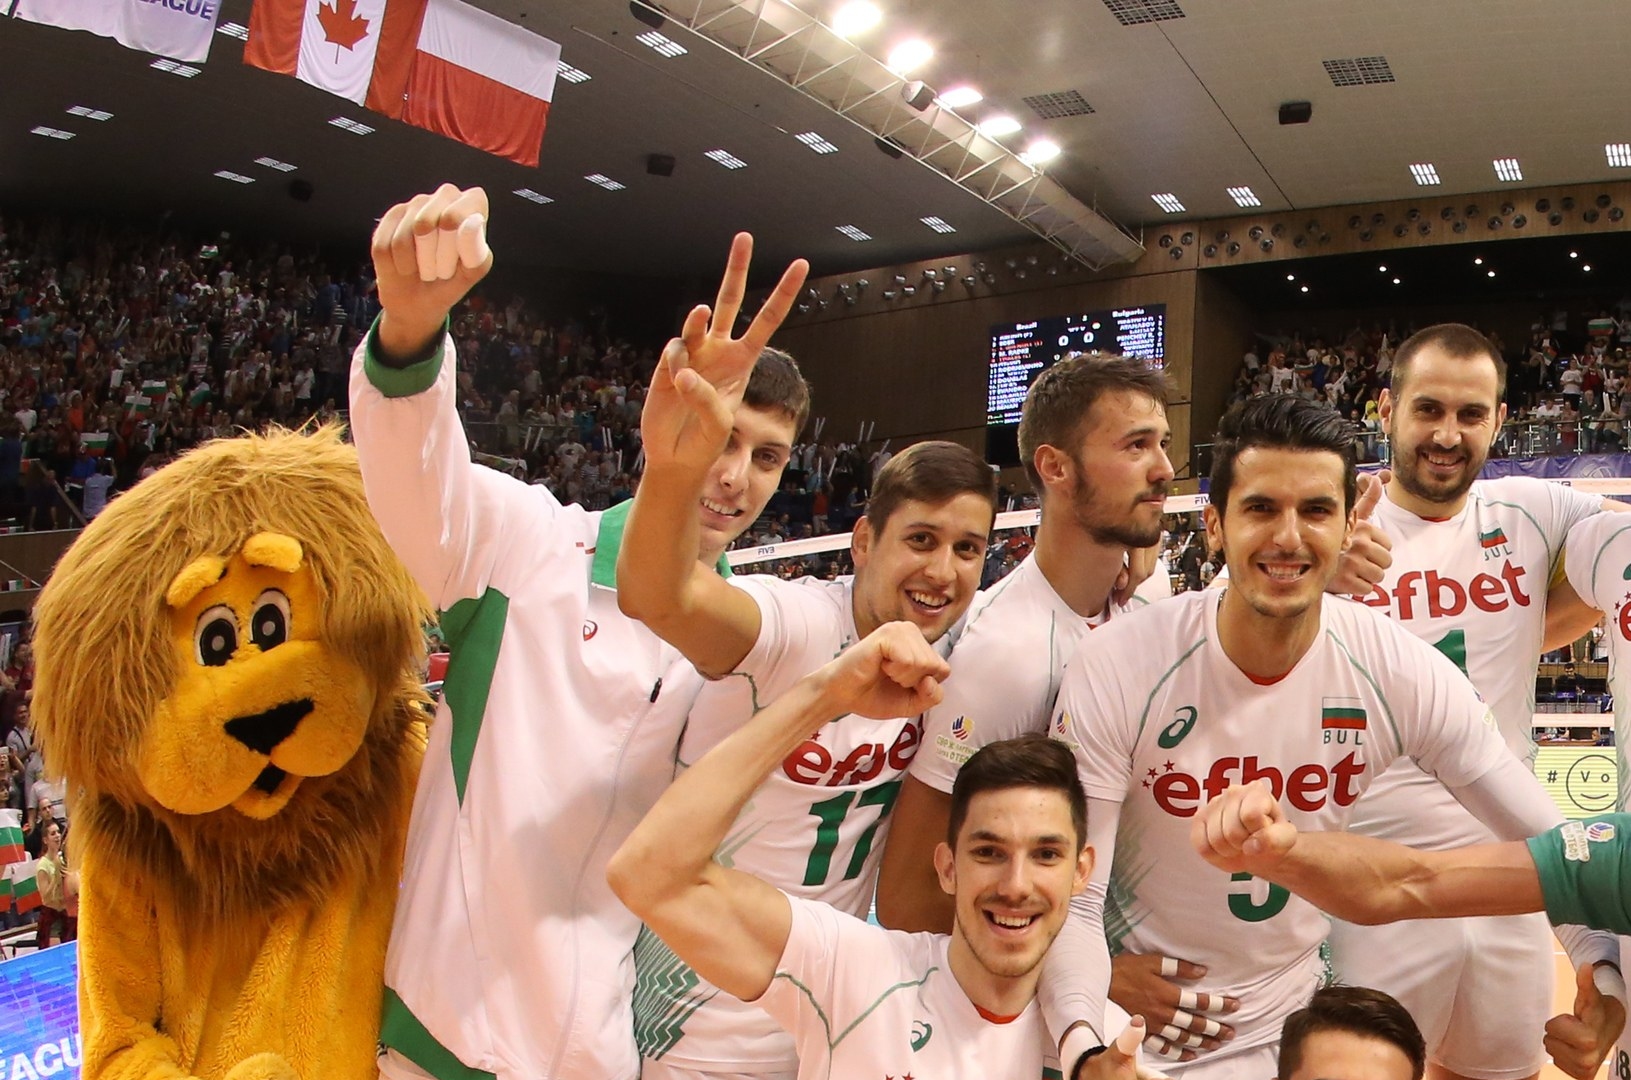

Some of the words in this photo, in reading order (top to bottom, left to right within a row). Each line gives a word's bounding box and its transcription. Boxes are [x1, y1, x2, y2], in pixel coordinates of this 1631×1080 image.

[1194, 496, 1210, 505] FIV
[1352, 559, 1531, 620] efbet
[1322, 729, 1364, 746] BUL
[1152, 751, 1366, 818] efbet
[801, 780, 903, 886] 17
